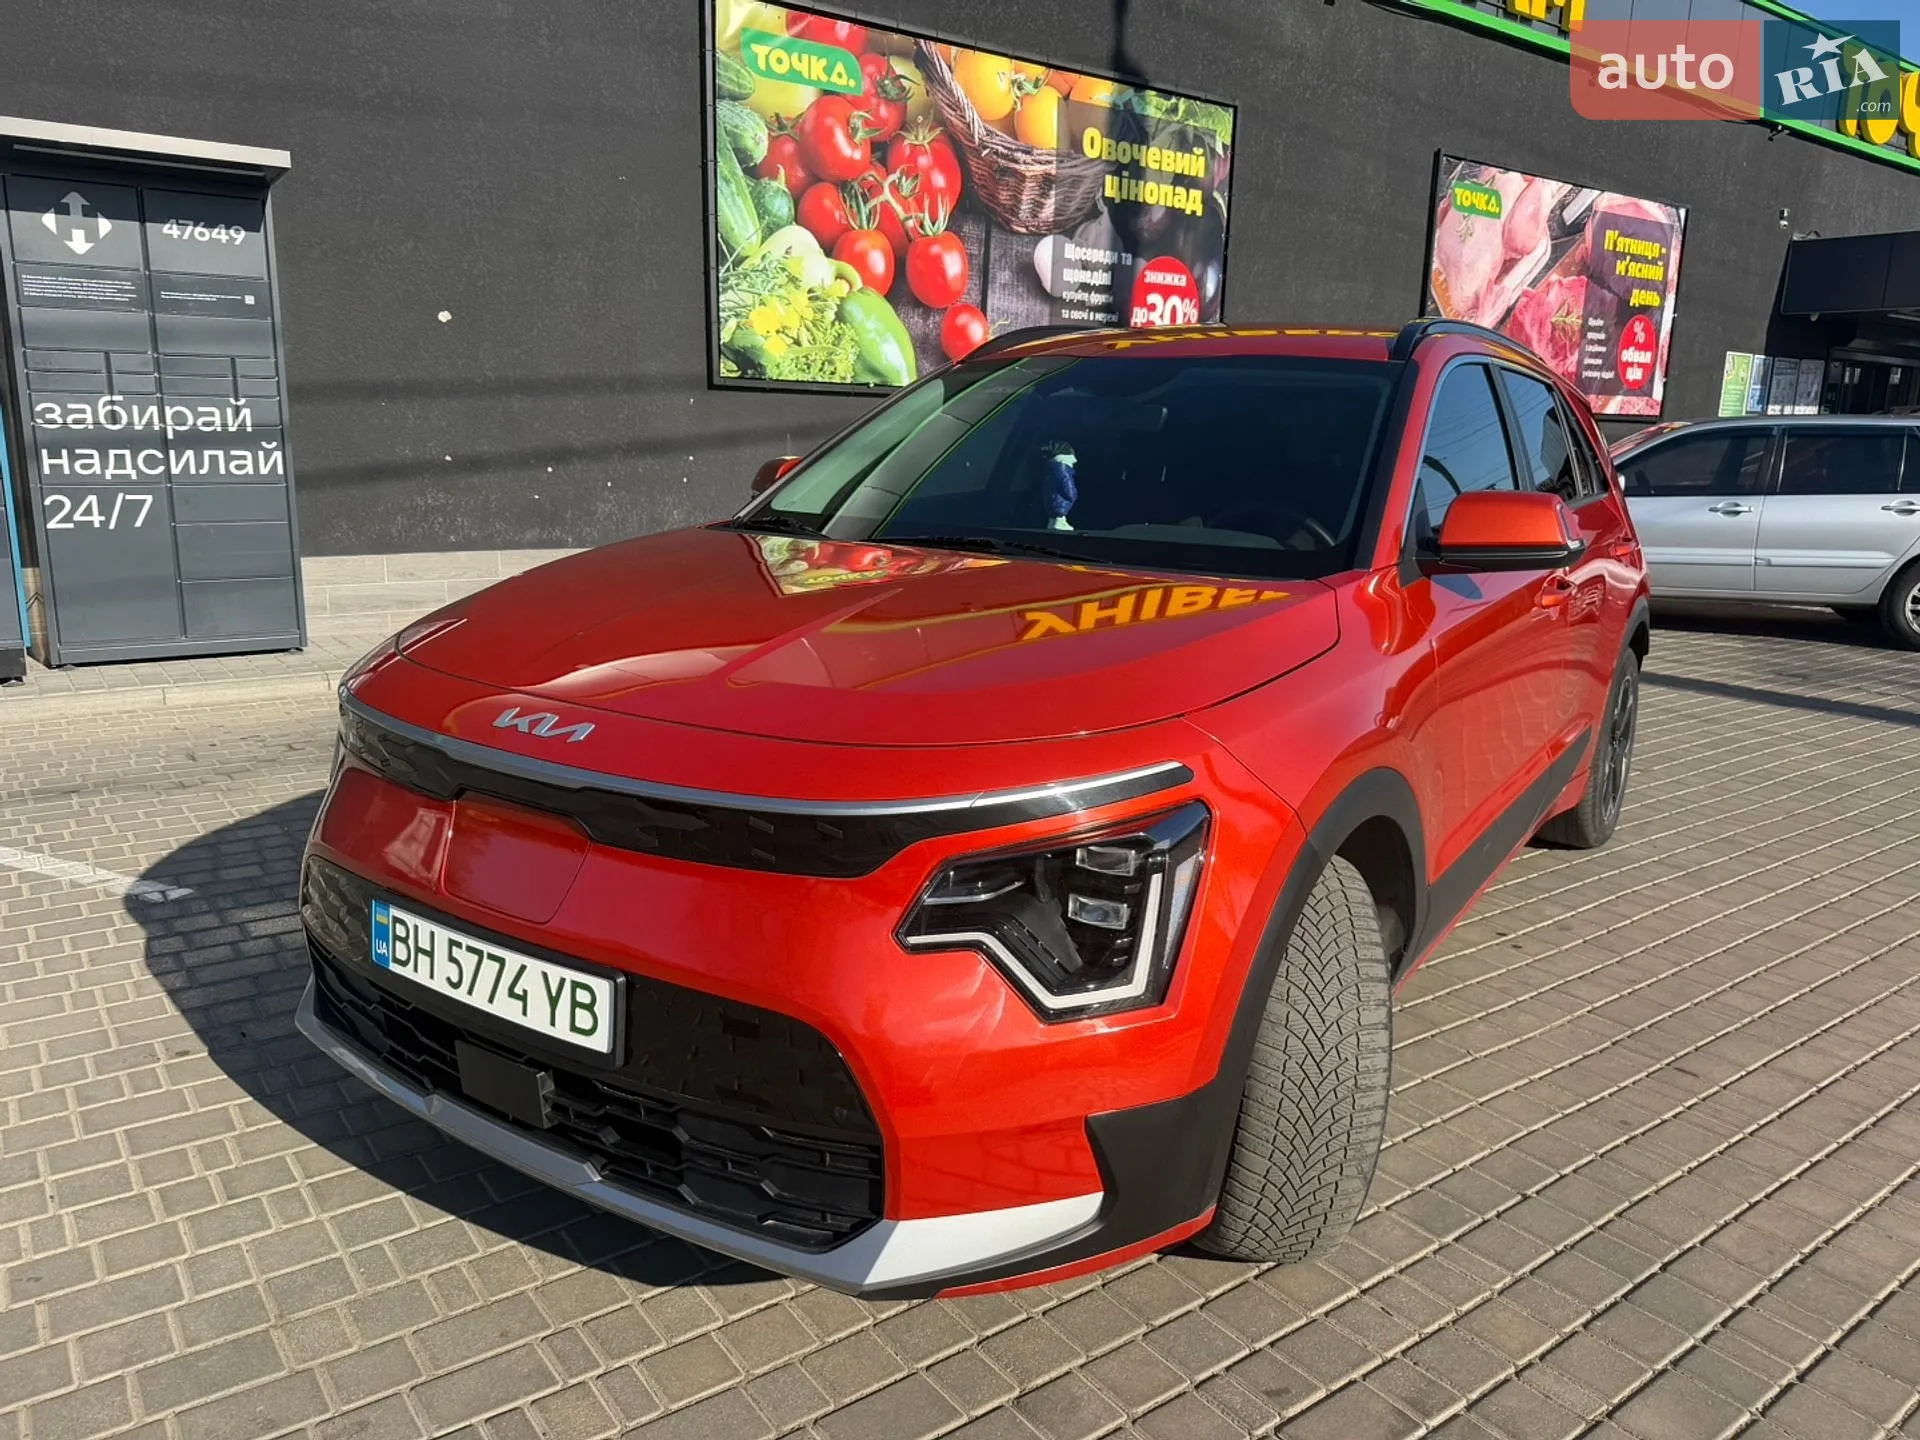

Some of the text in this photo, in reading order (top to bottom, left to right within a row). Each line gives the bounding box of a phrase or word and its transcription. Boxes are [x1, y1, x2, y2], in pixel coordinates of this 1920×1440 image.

[1083, 127, 1205, 178] Овочевий
[1104, 171, 1203, 216] цінопад
[162, 219, 246, 245] 47649
[1064, 243, 1133, 265] Щосереди та
[1144, 270, 1187, 286] знижка
[1629, 288, 1661, 307] день
[1621, 346, 1652, 364] обвал
[1626, 364, 1643, 382] цін
[34, 395, 252, 439] забирай
[41, 441, 284, 480] надсилай
[43, 492, 153, 530] 24/7
[492, 706, 596, 742] KIA
[375, 938, 388, 957] UA
[392, 914, 599, 1037] BH 5774 YB
